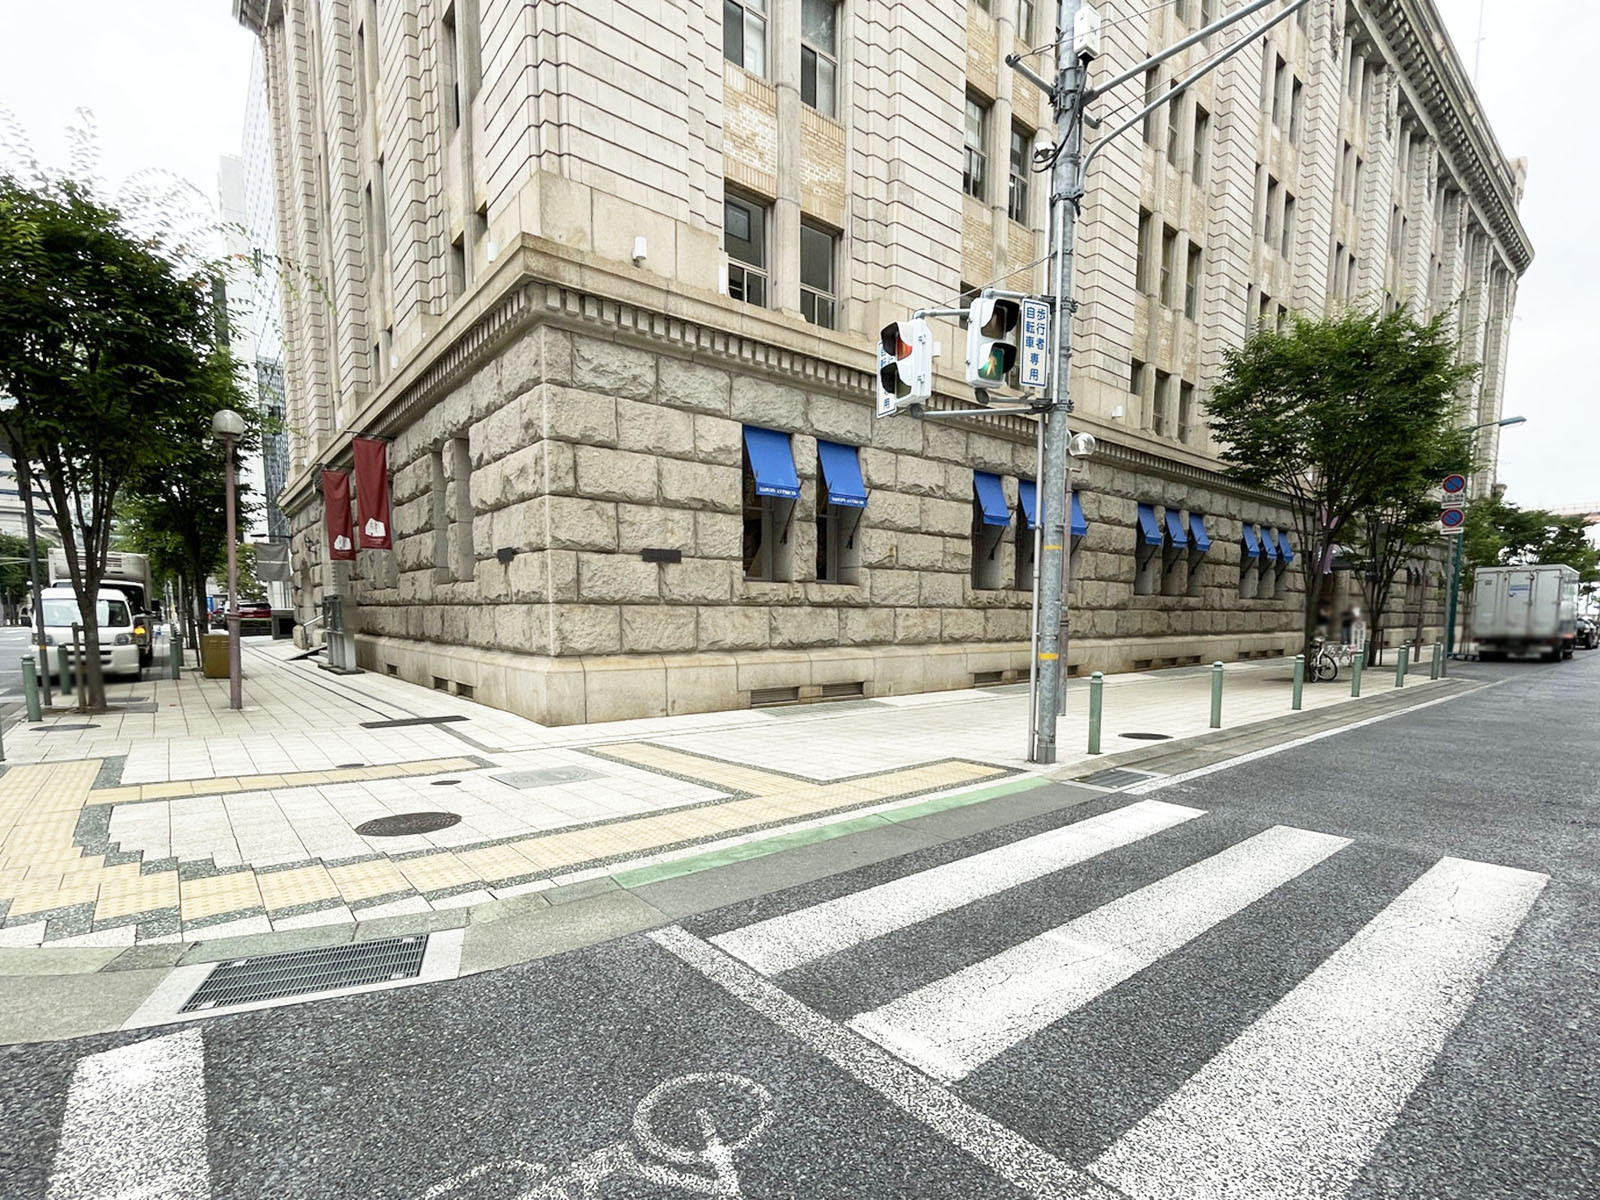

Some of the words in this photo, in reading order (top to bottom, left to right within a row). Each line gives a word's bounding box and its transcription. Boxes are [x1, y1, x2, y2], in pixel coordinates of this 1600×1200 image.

[1025, 306, 1036, 348] 自転車
[1035, 308, 1046, 350] 歩行者
[1029, 352, 1040, 382] 専用
